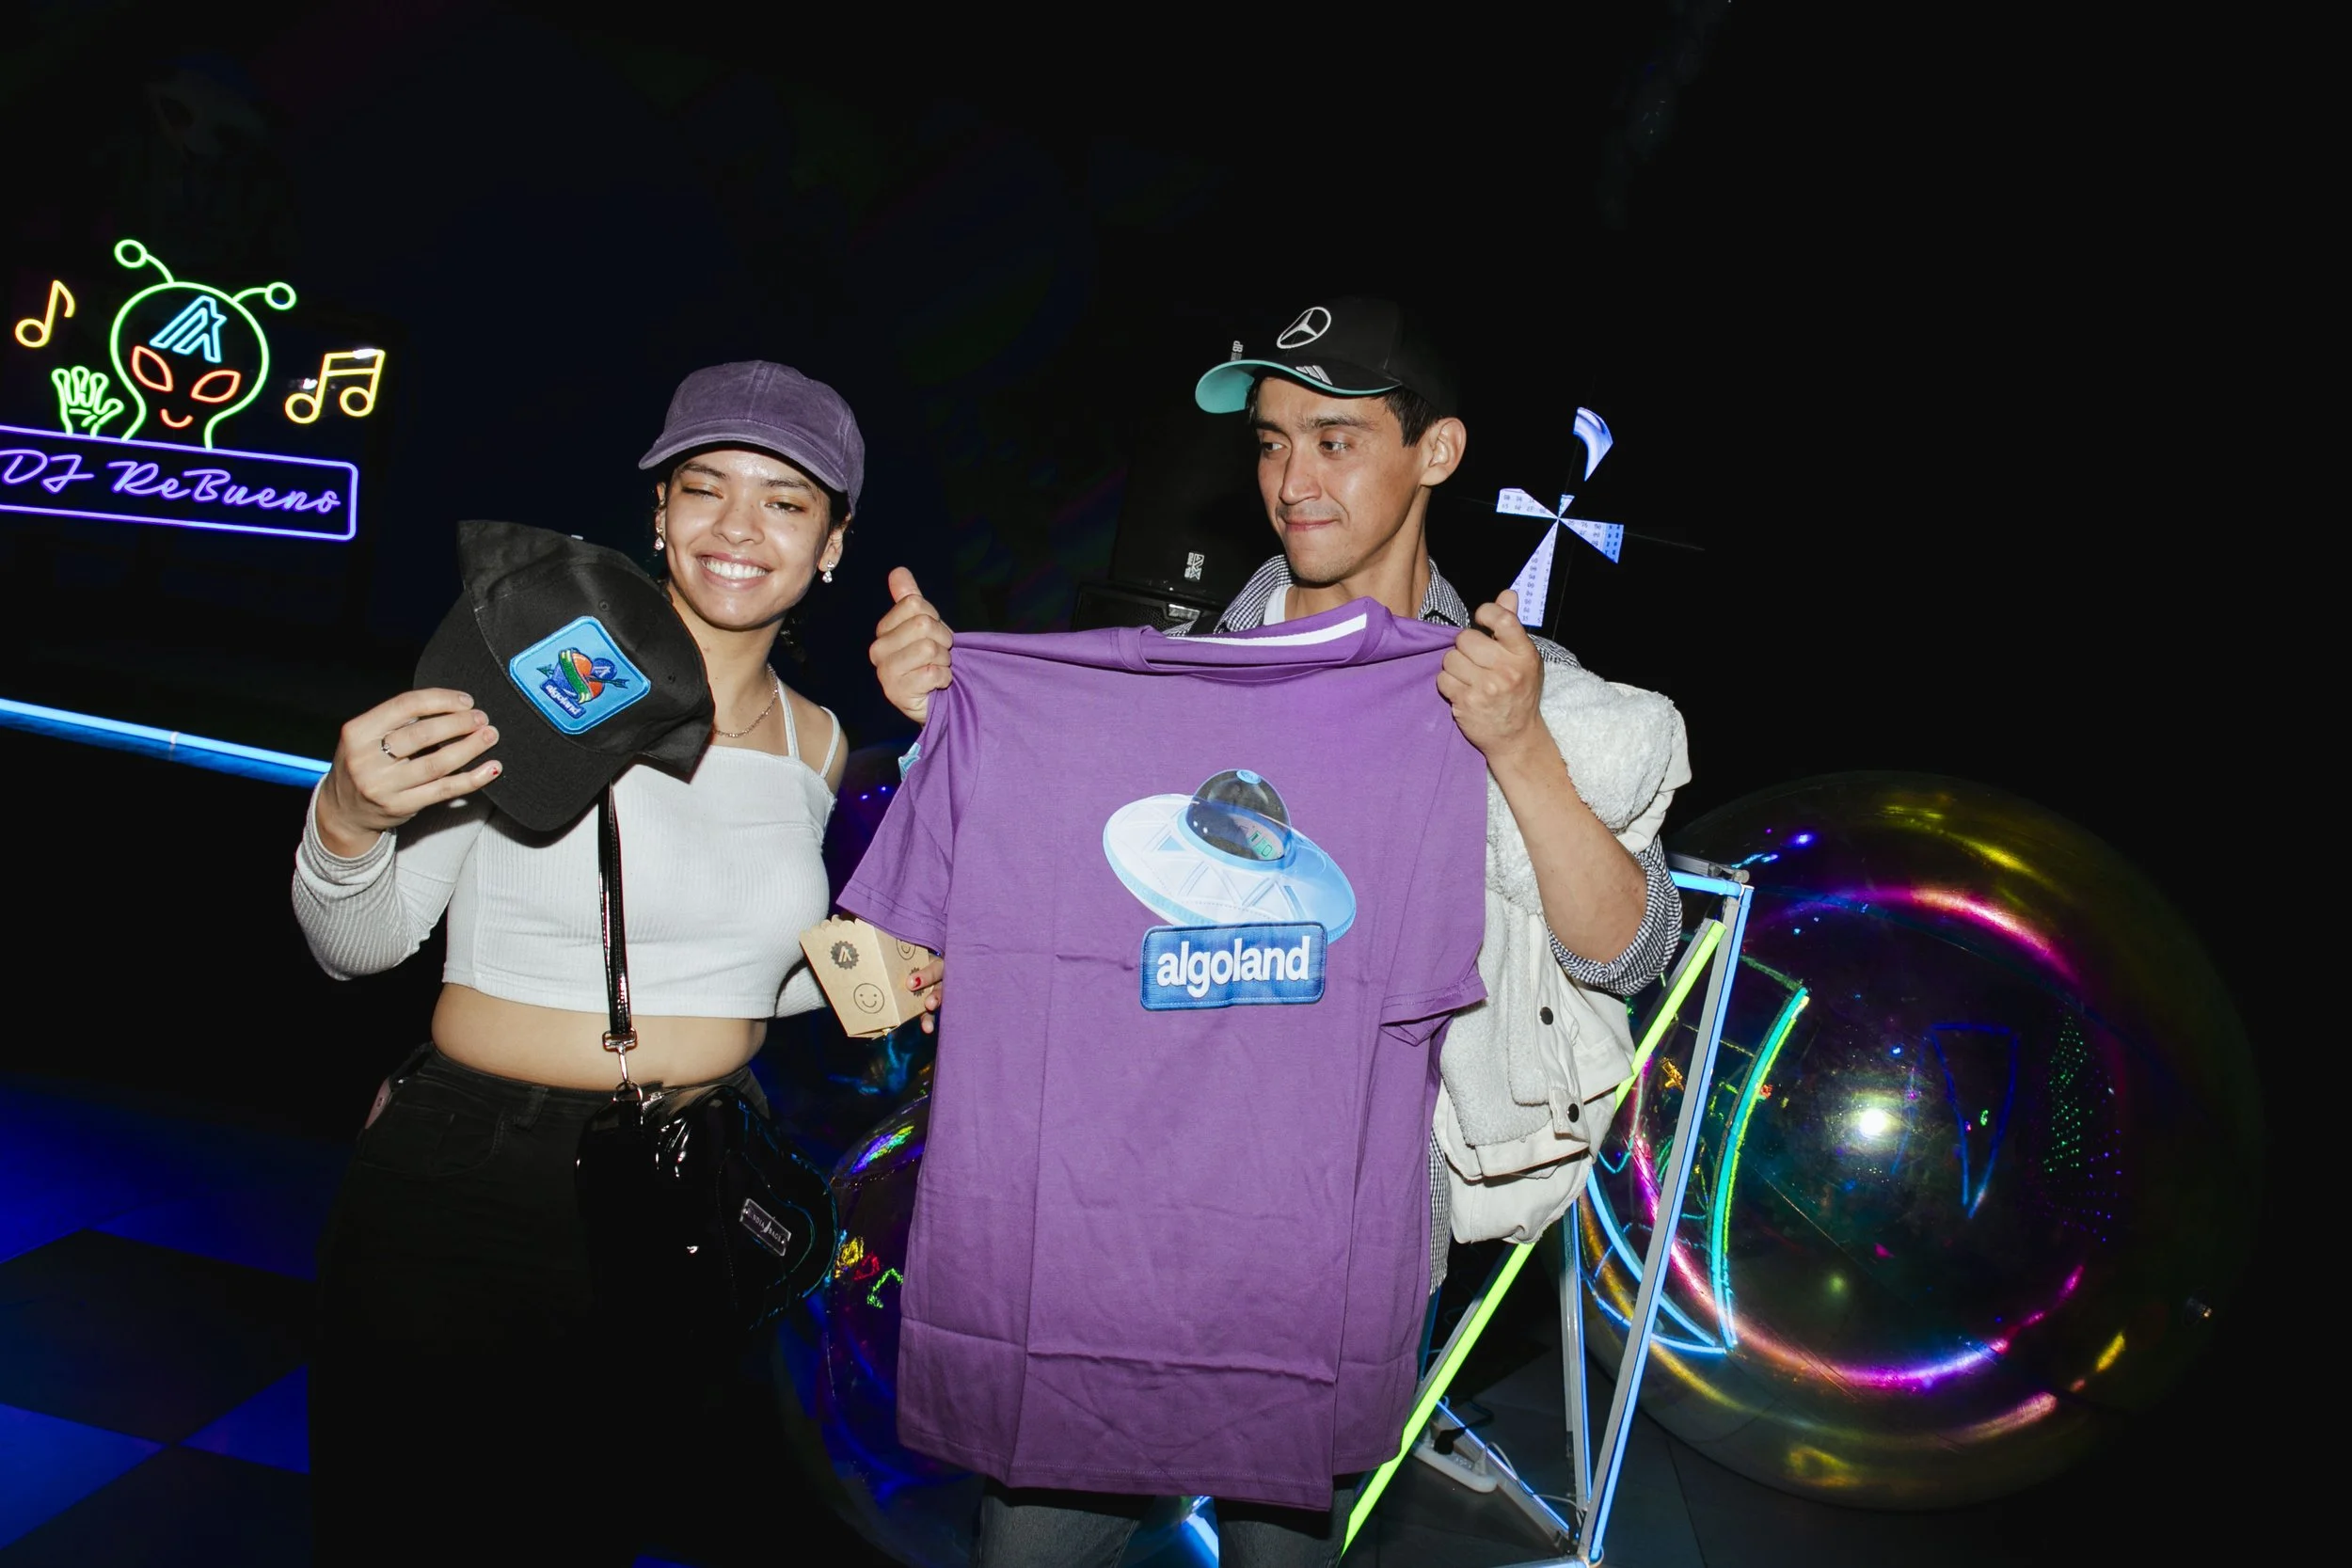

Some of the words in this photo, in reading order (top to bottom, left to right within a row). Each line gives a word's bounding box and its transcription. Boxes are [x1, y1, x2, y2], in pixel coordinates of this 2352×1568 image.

[0, 449, 94, 493] DJ
[107, 461, 342, 513] ReBueno
[545, 684, 581, 716] algoland
[1156, 935, 1311, 998] algoland
